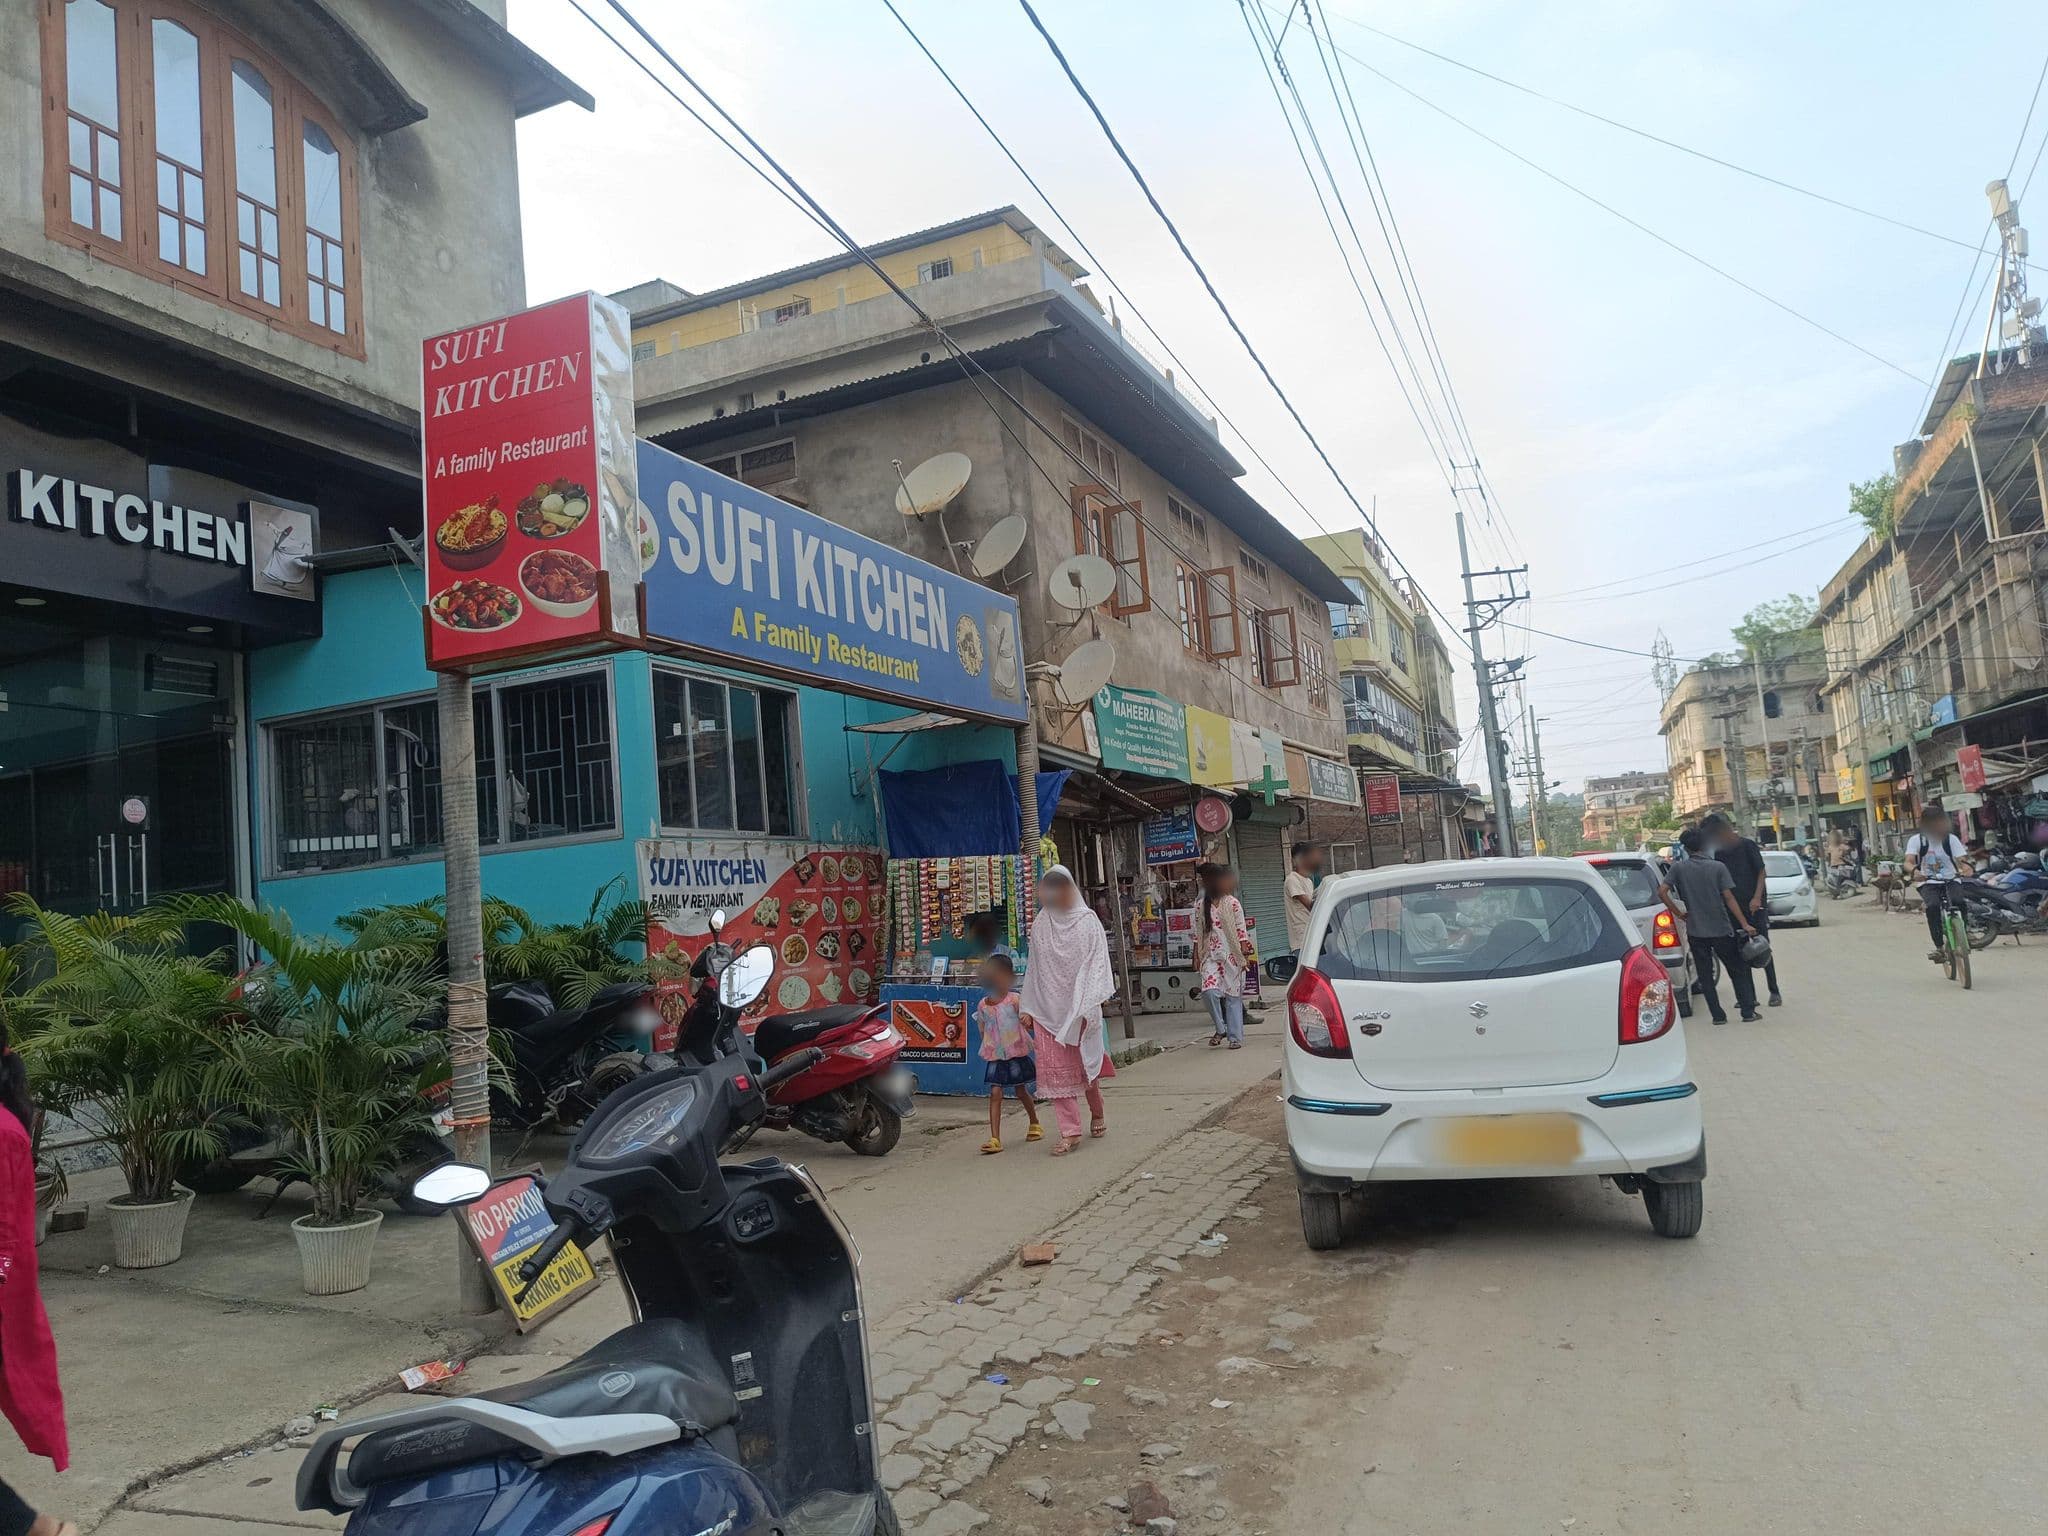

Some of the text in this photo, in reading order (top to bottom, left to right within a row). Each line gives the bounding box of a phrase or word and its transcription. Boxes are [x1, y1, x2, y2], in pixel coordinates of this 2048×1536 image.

[431, 318, 510, 371] SUFI
[432, 351, 583, 418] KITCHEN
[434, 425, 588, 479] A family Restaurant
[18, 469, 247, 567] KITCHEN
[666, 480, 950, 653] SUFI KITCHEN
[731, 607, 921, 684] A Family Restaurant
[1112, 700, 1155, 723] MAHEERA
[650, 858, 768, 887] SUFI KITCHEN
[1160, 848, 1184, 858] Digital
[651, 892, 744, 910] FAMILY RESTAURANT
[1352, 1011, 1391, 1020] ALTO
[469, 1186, 545, 1242] NO PARKIN
[559, 1256, 586, 1287] ONLY
